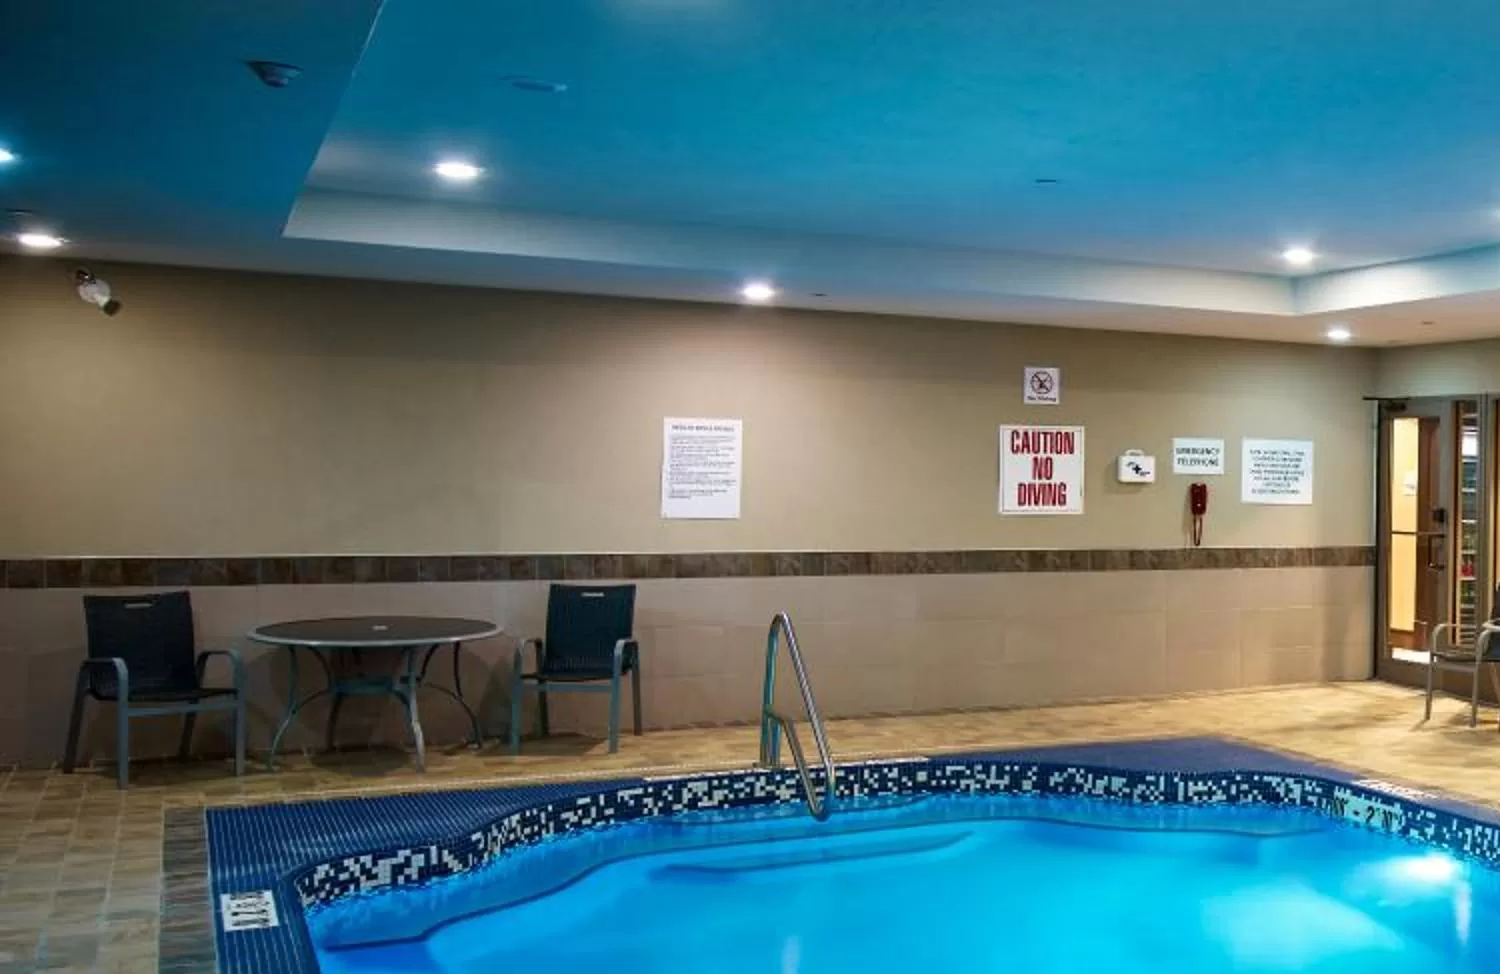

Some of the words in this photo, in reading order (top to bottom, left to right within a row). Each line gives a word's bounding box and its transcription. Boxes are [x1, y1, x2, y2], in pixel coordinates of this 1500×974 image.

[1010, 430, 1075, 455] CAUTION
[1032, 456, 1053, 480] NO
[1017, 483, 1067, 506] DIVING
